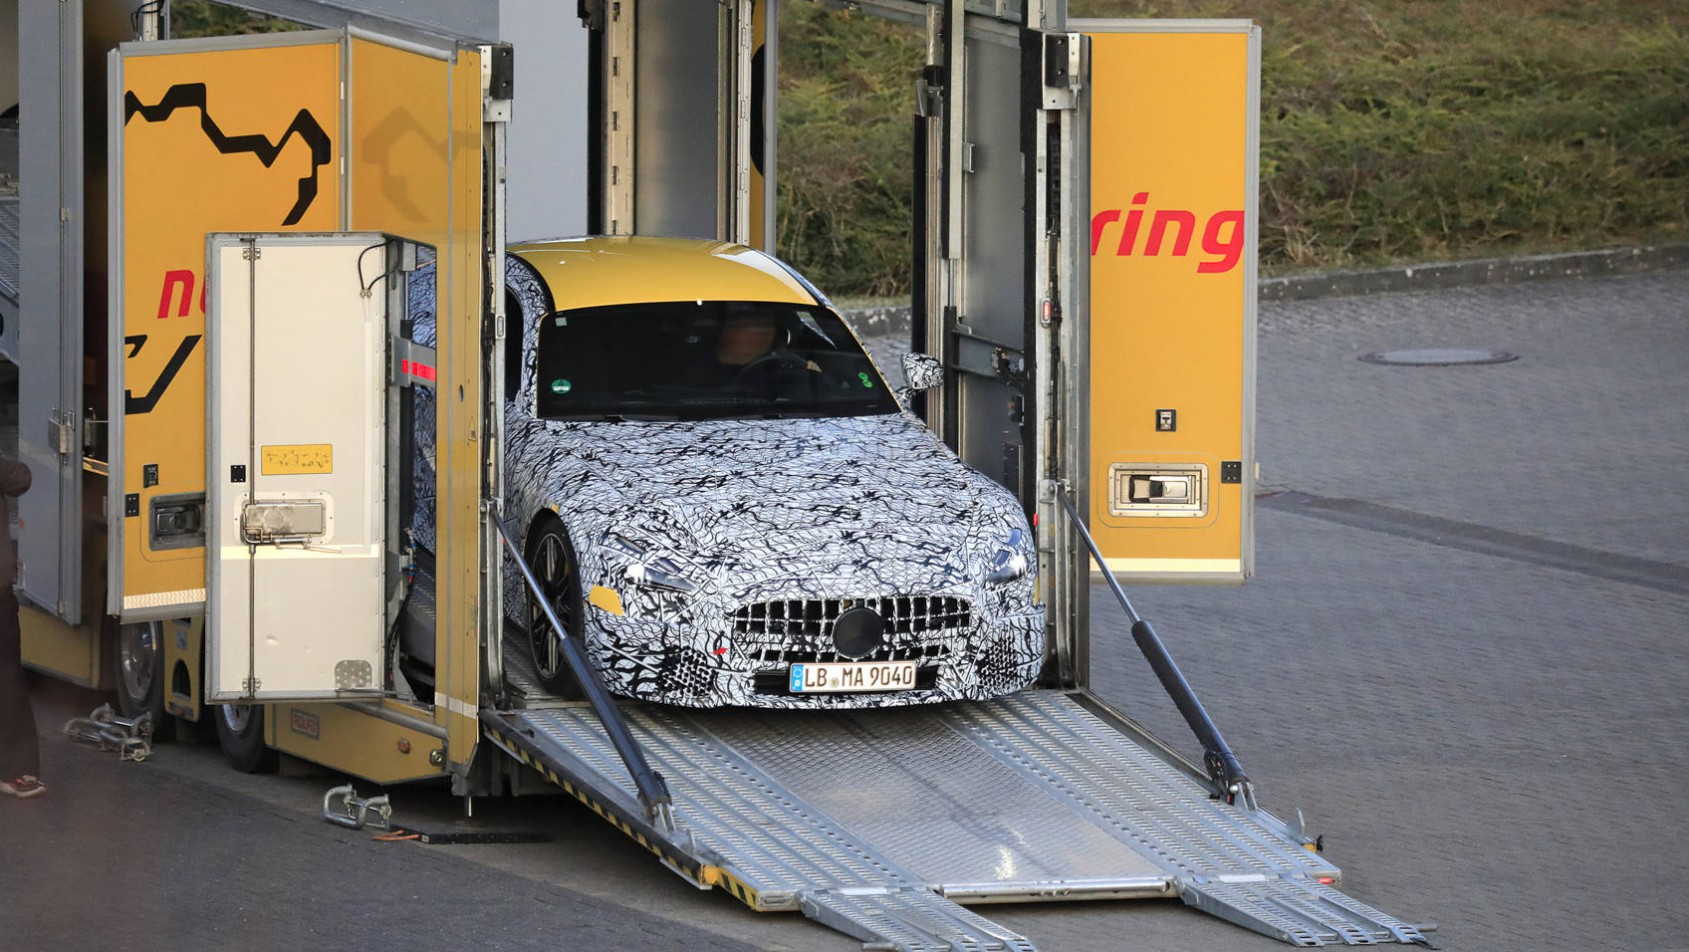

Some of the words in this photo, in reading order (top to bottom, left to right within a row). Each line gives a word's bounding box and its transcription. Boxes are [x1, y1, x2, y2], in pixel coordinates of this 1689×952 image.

[1091, 191, 1245, 274] ring
[157, 269, 205, 319] n
[805, 668, 827, 687] LB
[842, 667, 863, 686] MA
[870, 666, 912, 686] 9040
